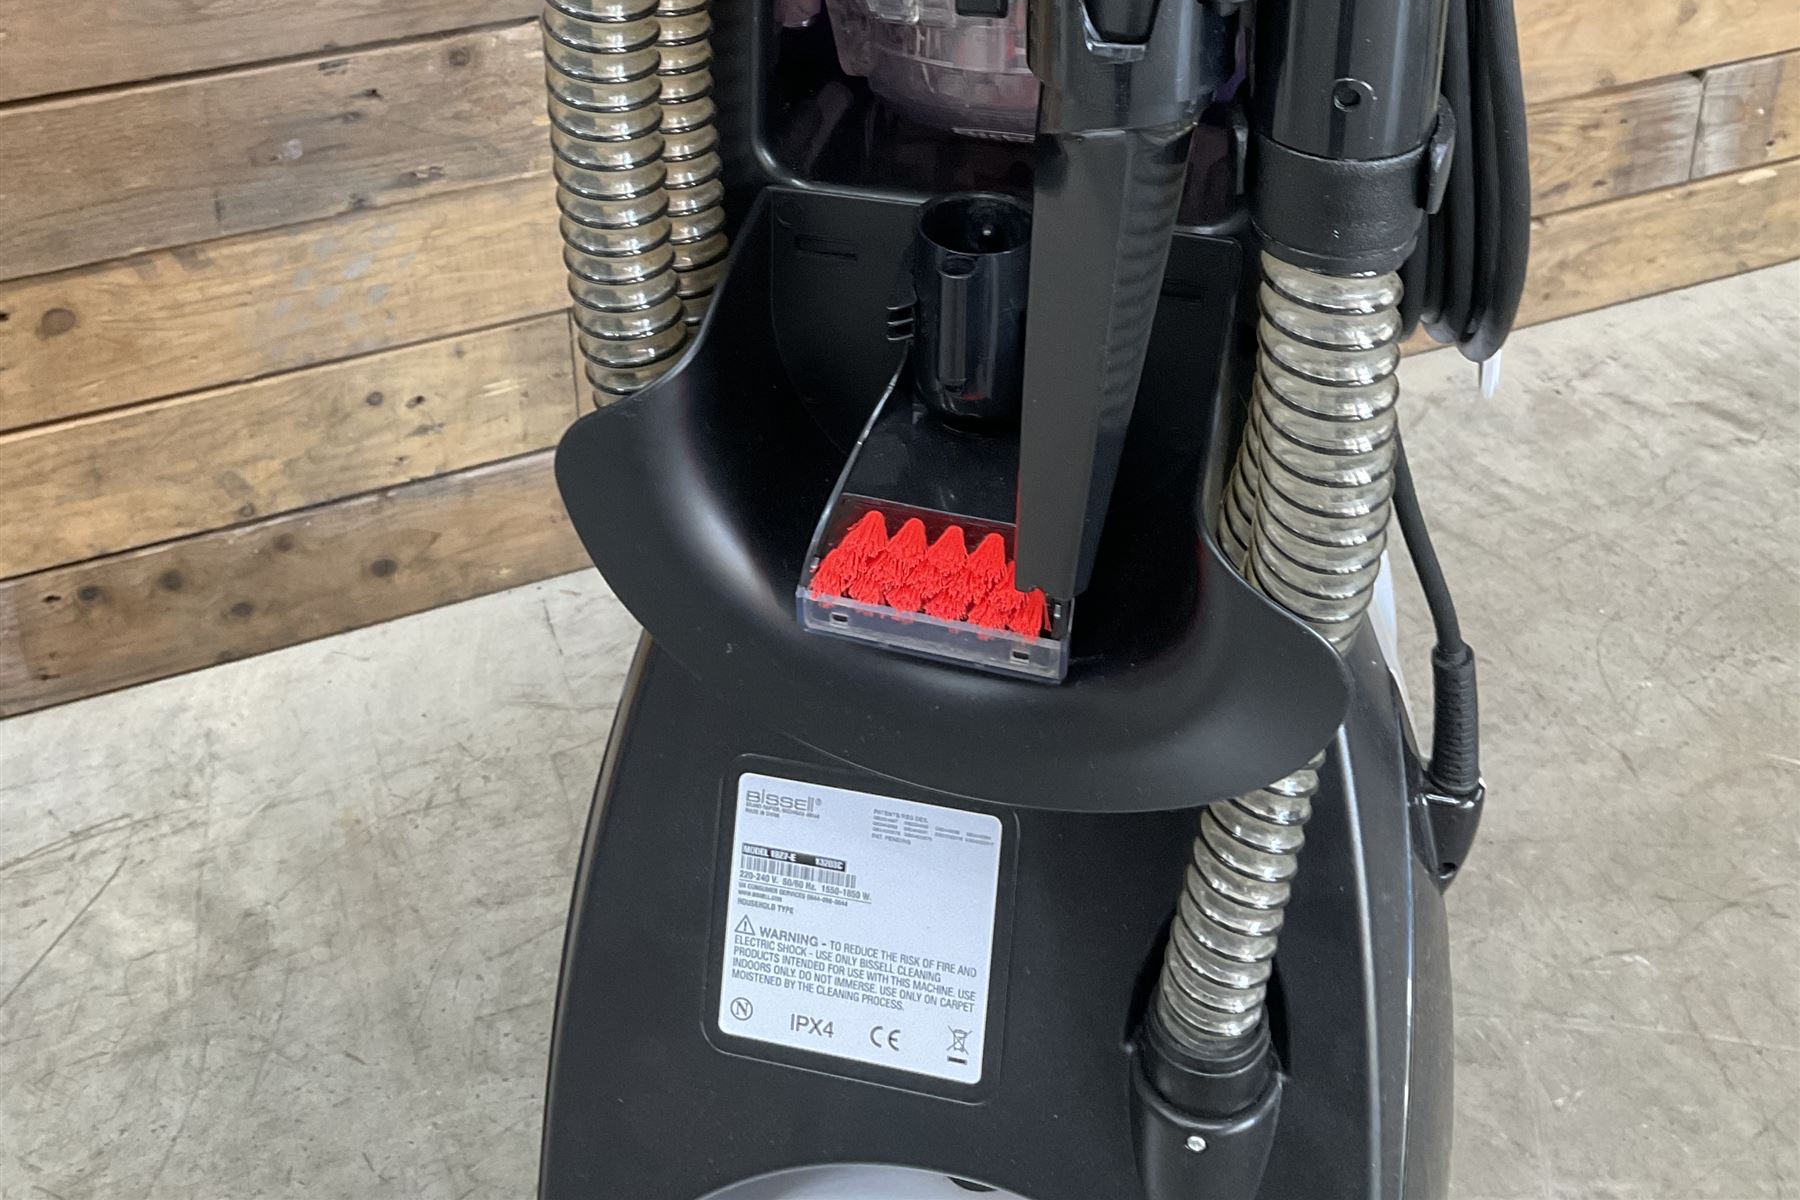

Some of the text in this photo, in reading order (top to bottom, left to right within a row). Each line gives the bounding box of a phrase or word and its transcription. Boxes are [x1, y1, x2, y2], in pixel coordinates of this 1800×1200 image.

[743, 845, 769, 857] MODEL
[740, 870, 770, 882] 220-240
[782, 878, 804, 888] 50/60
[822, 885, 861, 898] 1550-1850
[738, 898, 794, 914] HOUSEHOLD TYPE
[734, 934, 775, 951] ELECTRIC
[777, 942, 807, 957] SHOCK
[815, 950, 833, 962] USE
[835, 953, 857, 966] ONLY
[859, 959, 894, 974] BISSELL
[897, 965, 941, 983] CLEANING
[759, 926, 818, 947] WARNING
[830, 940, 841, 951] TO
[843, 943, 878, 959] REDUCE
[881, 950, 897, 962] THE
[900, 953, 920, 967] RISK
[922, 958, 935, 969] OF
[937, 961, 955, 974] FIRE
[957, 965, 977, 978] AND
[732, 969, 904, 1011] MOISTENED BY THE CLEANING PROCESS.
[733, 957, 771, 973] INDOORS
[799, 970, 812, 981] DO
[814, 972, 832, 985] NOT
[834, 976, 877, 994] IMMERSE.
[880, 985, 897, 997] USE
[899, 989, 922, 1002] ONLY
[924, 994, 937, 1006] ON
[940, 997, 975, 1013] CARPET
[734, 945, 977, 1001] PRODUCTS INTENDED FOR USE WITH THIS MACHINE. USE
[790, 1013, 834, 1038] IPX4
[870, 1025, 901, 1051] CE
